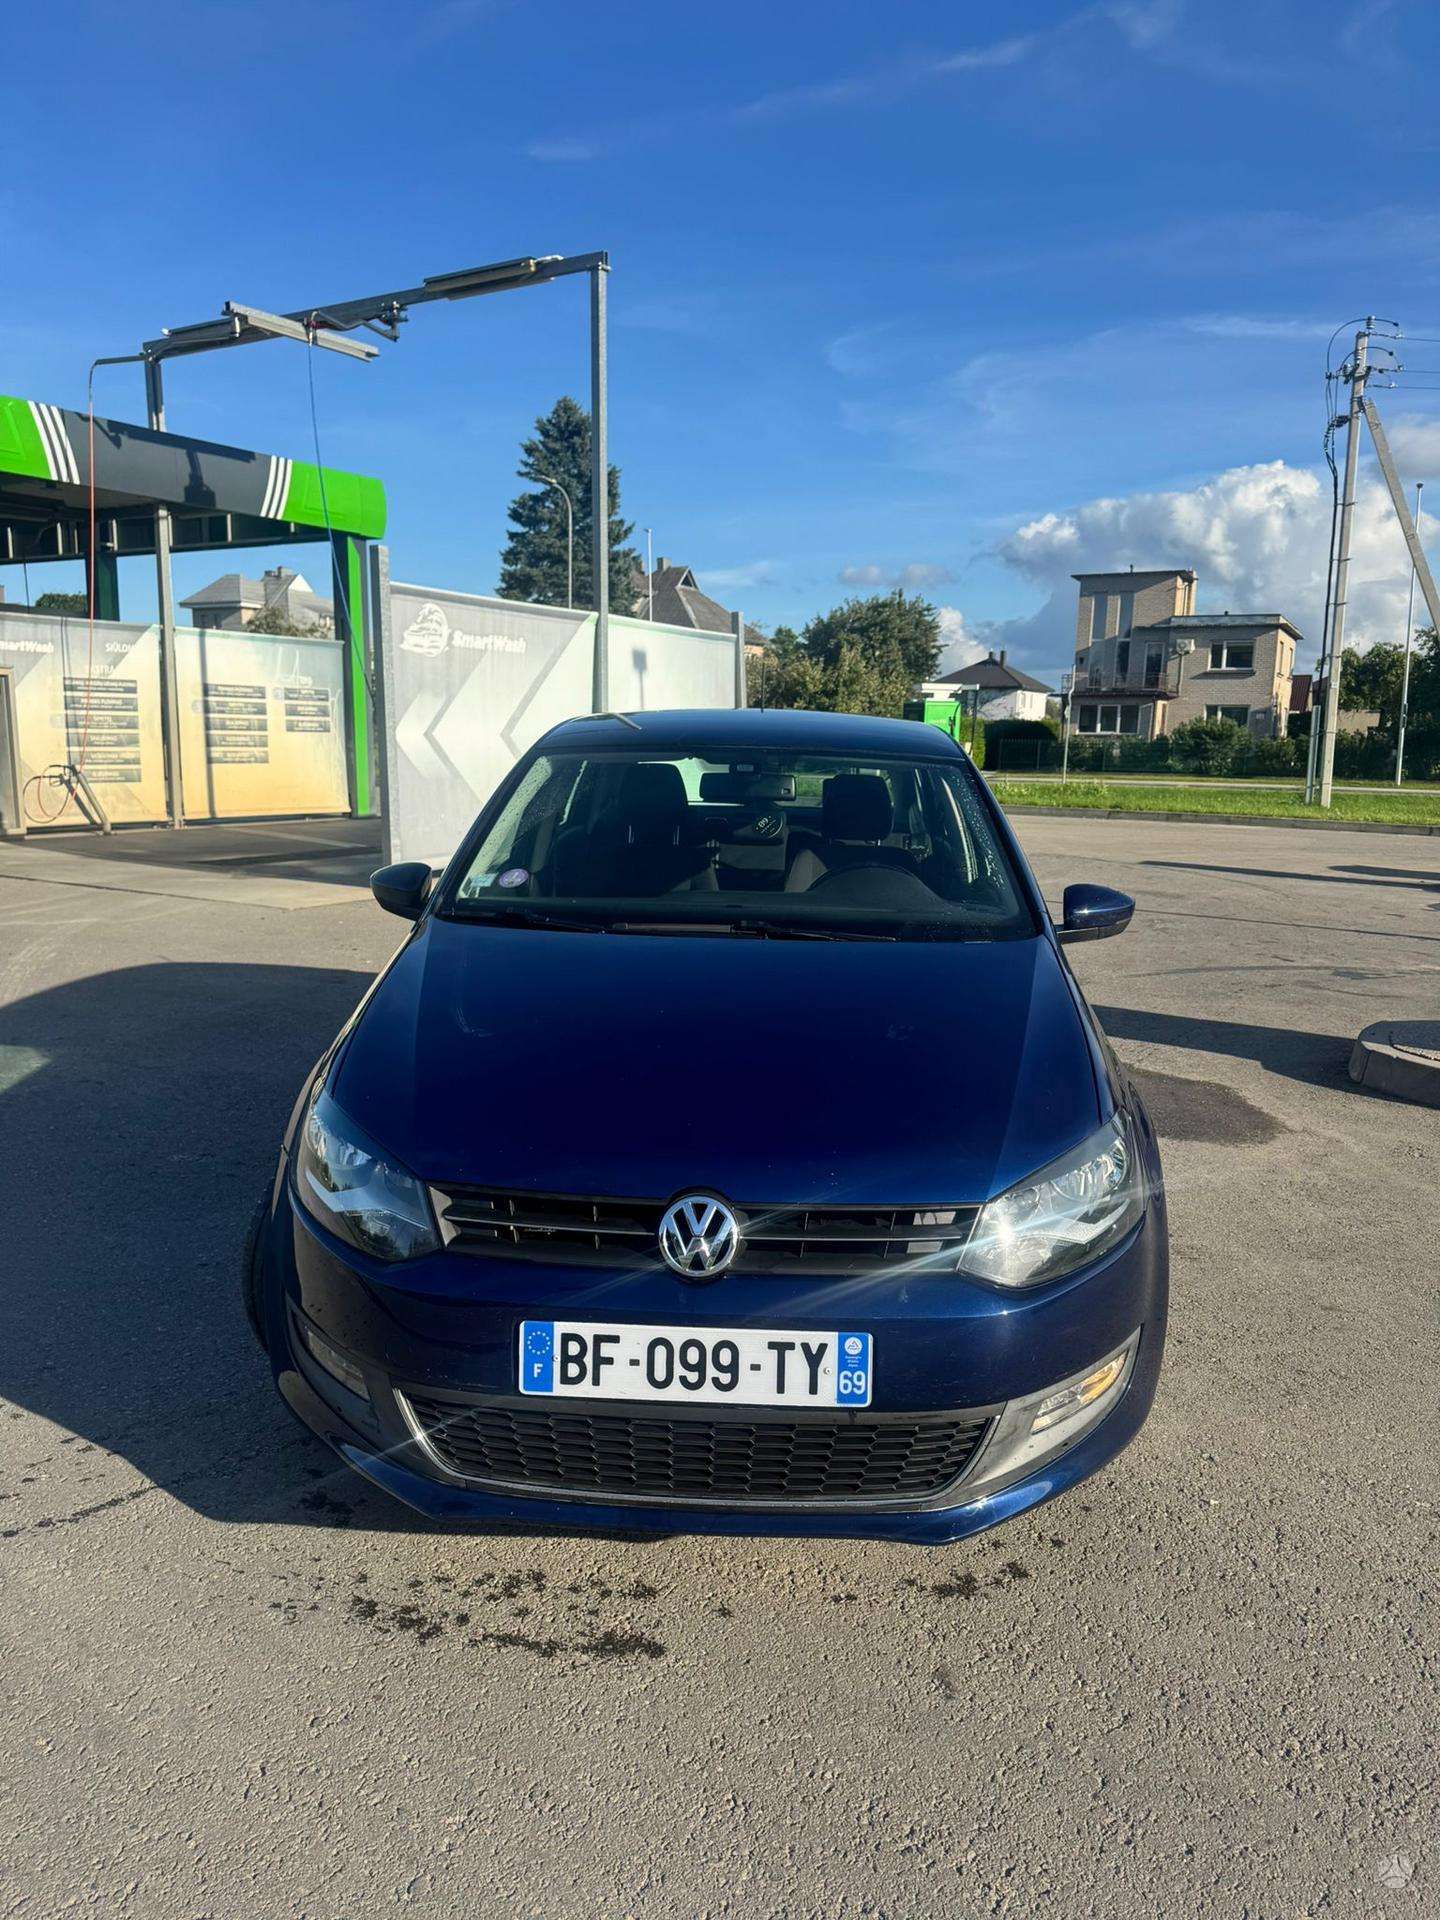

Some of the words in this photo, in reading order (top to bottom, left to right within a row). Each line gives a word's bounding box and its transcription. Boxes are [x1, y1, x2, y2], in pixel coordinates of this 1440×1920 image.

[0, 639, 54, 654] martWash
[451, 629, 527, 653] SmartWash
[533, 1363, 543, 1378] F
[560, 1333, 829, 1395] BF-099-TY
[838, 1370, 867, 1395] 69
